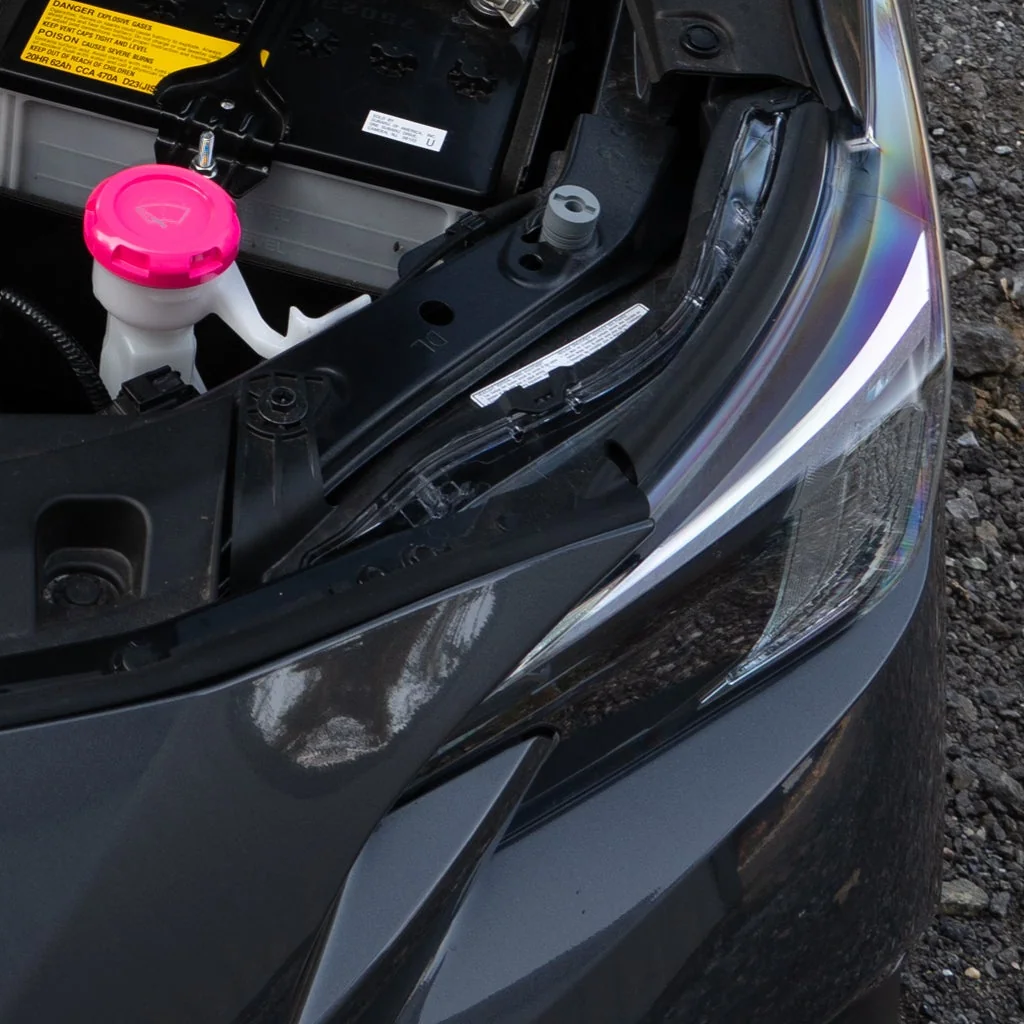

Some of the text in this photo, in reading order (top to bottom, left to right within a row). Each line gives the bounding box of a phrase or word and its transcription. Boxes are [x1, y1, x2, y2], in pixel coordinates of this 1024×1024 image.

[53, 0, 95, 15] DANGER
[97, 12, 130, 25] EXPLOSIVE
[132, 21, 152, 31] GASES
[38, 29, 80, 44] POISON
[82, 41, 106, 51] CAUSES
[107, 47, 131, 58] SEVERE
[133, 54, 154, 64] BURNS
[76, 30, 94, 38] CAPS
[95, 34, 113, 43] TIGHT
[129, 43, 147, 53] LEVEL
[25, 52, 49, 63] 20HR
[50, 58, 72, 70] 62Ah
[75, 65, 95, 76] CCA
[97, 72, 118, 82] 470A
[70, 56, 92, 66] REACH
[103, 63, 135, 76] CHILDREN
[426, 138, 435, 147] U
